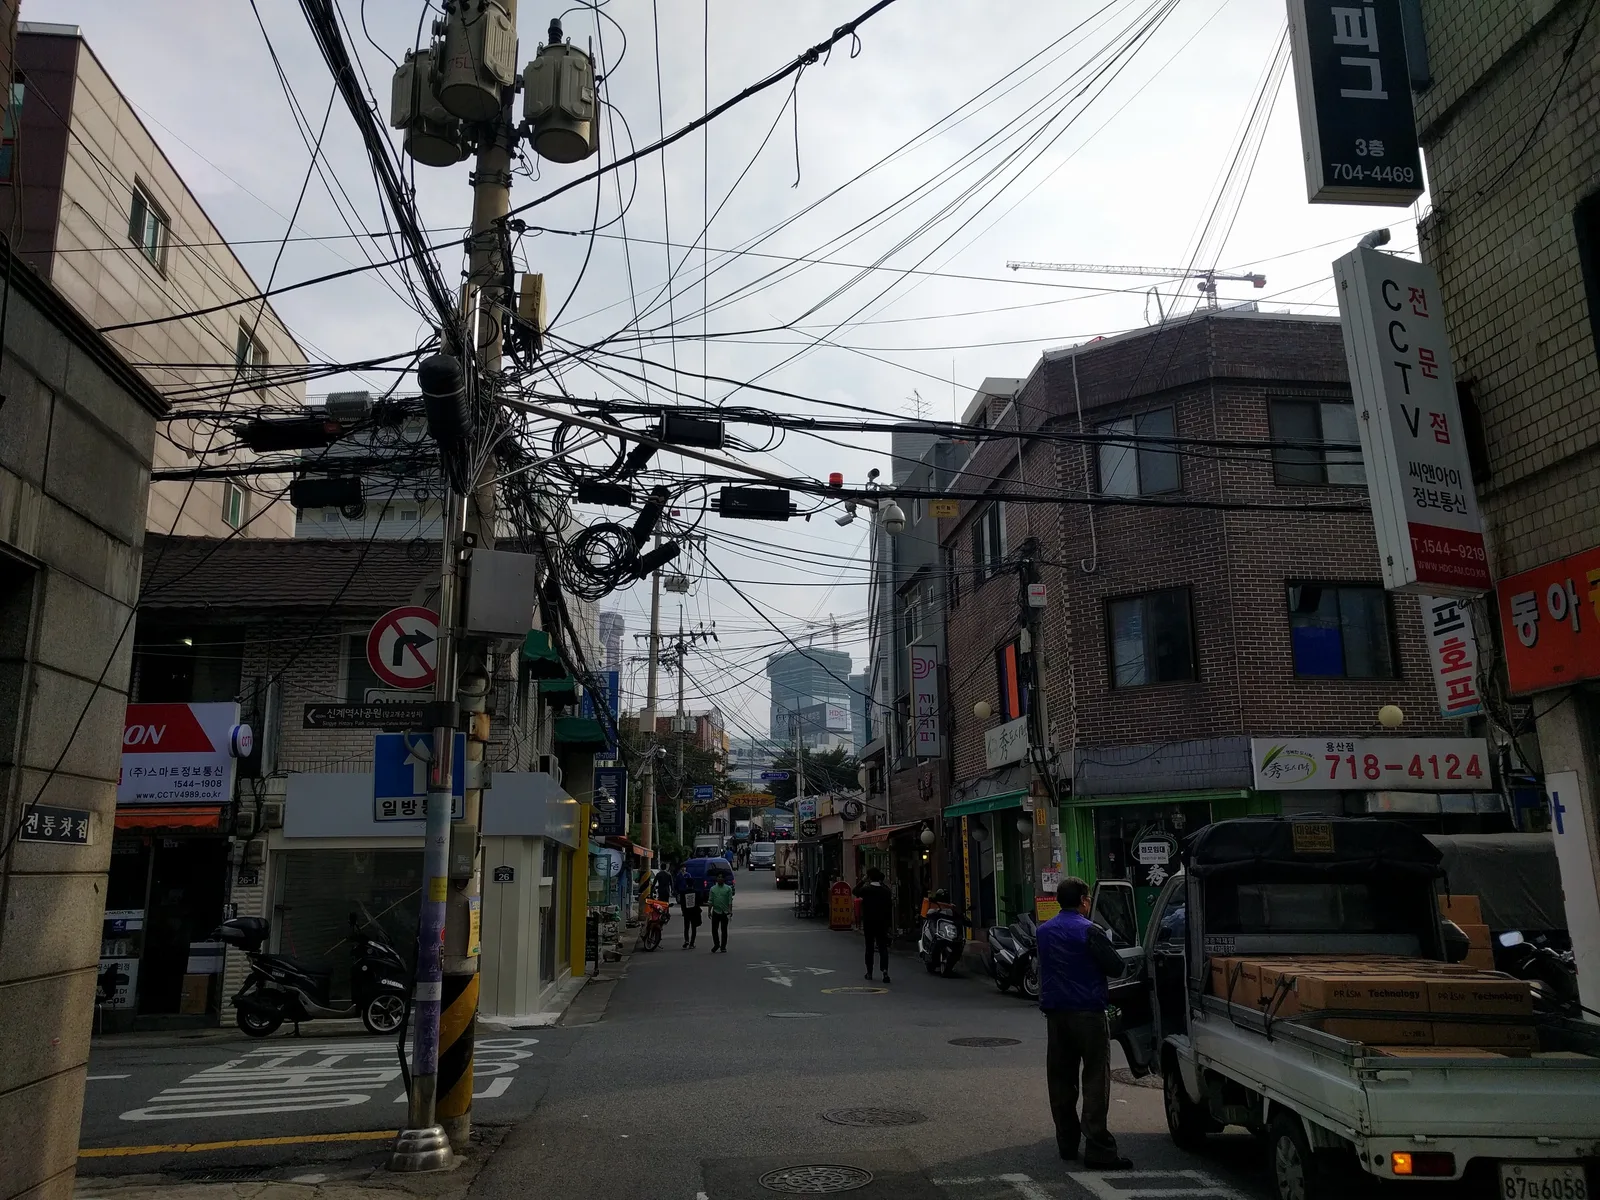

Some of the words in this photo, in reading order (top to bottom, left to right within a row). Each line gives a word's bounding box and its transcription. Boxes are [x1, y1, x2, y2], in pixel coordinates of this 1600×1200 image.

[1330, 0, 1389, 101] 피그
[1354, 138, 1385, 157] 3층
[1331, 163, 1414, 183] 704-4469
[1381, 277, 1421, 440] CCTV
[1408, 460, 1463, 490] 씨앤아이
[1412, 486, 1468, 515] 정보통신
[1411, 537, 1486, 561] T.1544-9219
[122, 724, 167, 745] ON
[1326, 742, 1355, 752] 용산점
[129, 765, 223, 778] (주)스마트정보통신
[1325, 754, 1484, 780] 718-4124
[173, 779, 222, 788] 1544-1908
[136, 790, 221, 799] www.CCTV4989.co.kr
[24, 812, 89, 840] 전통찻집
[238, 876, 257, 884] 26-1
[498, 873, 510, 881] 26
[1368, 988, 1420, 999] Technology
[1471, 991, 1525, 1002] Technology
